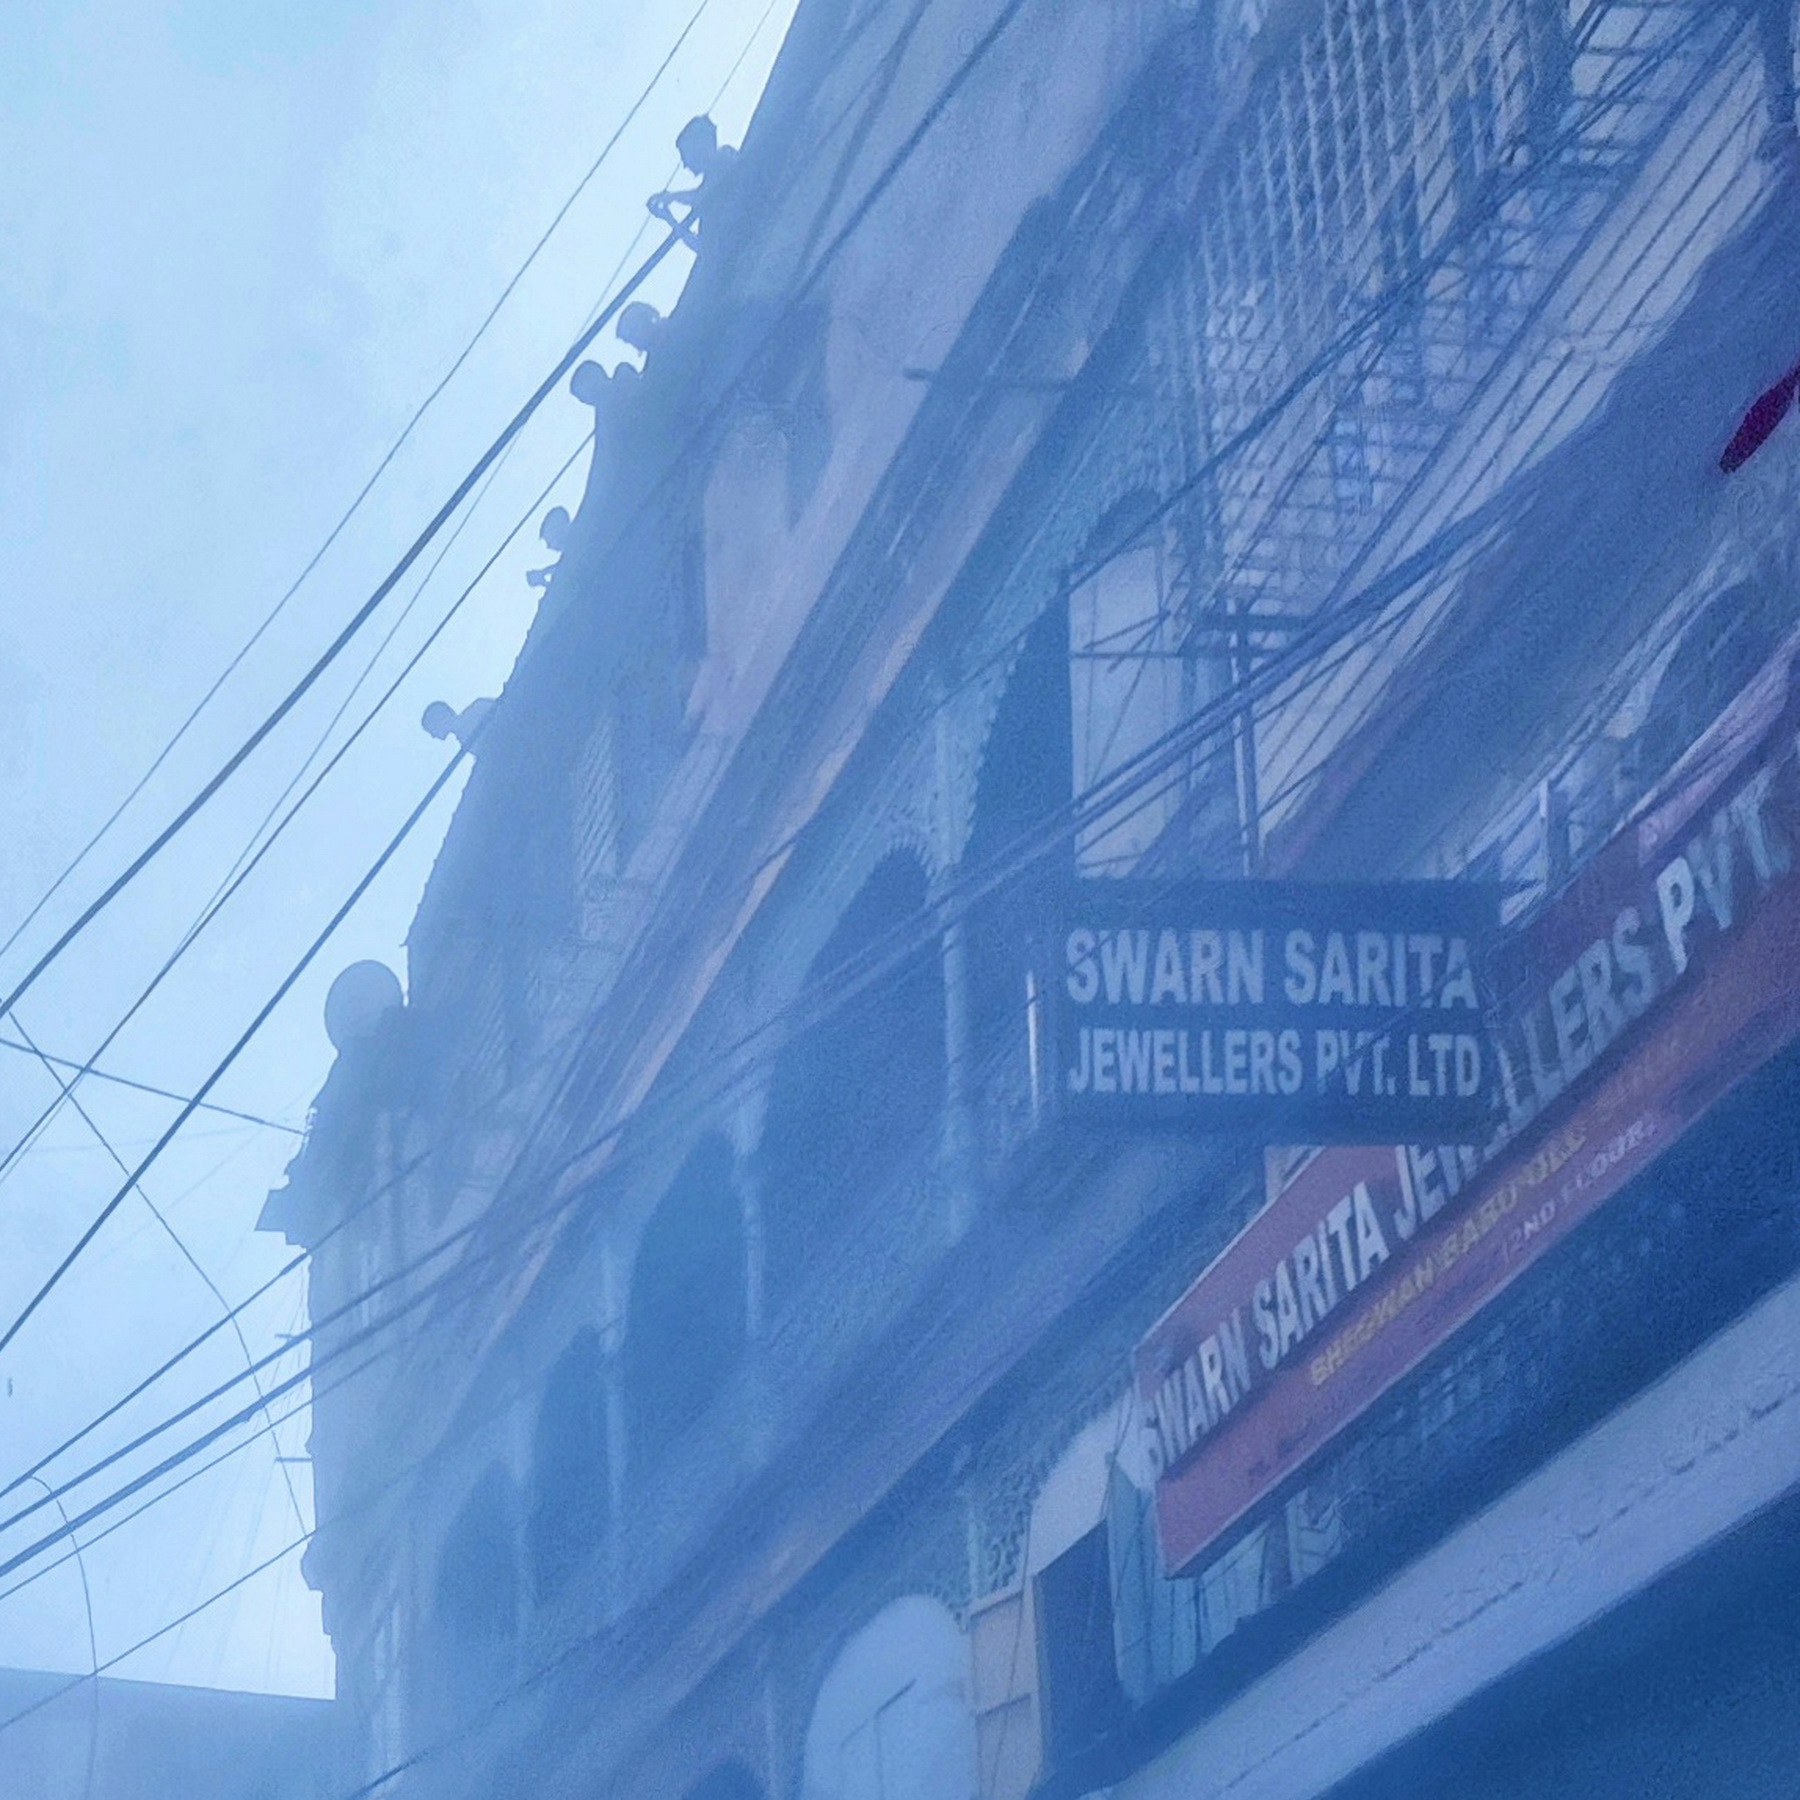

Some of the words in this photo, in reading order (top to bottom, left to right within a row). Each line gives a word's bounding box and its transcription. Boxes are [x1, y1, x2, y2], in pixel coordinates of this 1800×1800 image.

[1066, 928, 1264, 1005] SWARN
[1285, 928, 1479, 1009] SARITA
[1069, 1028, 1304, 1095] JEWELLERS
[1316, 1030, 1396, 1095] PVT.
[1409, 1034, 1481, 1097] LTD
[1138, 1309, 1251, 1472] SWARN
[1253, 1179, 1390, 1369] SARITA
